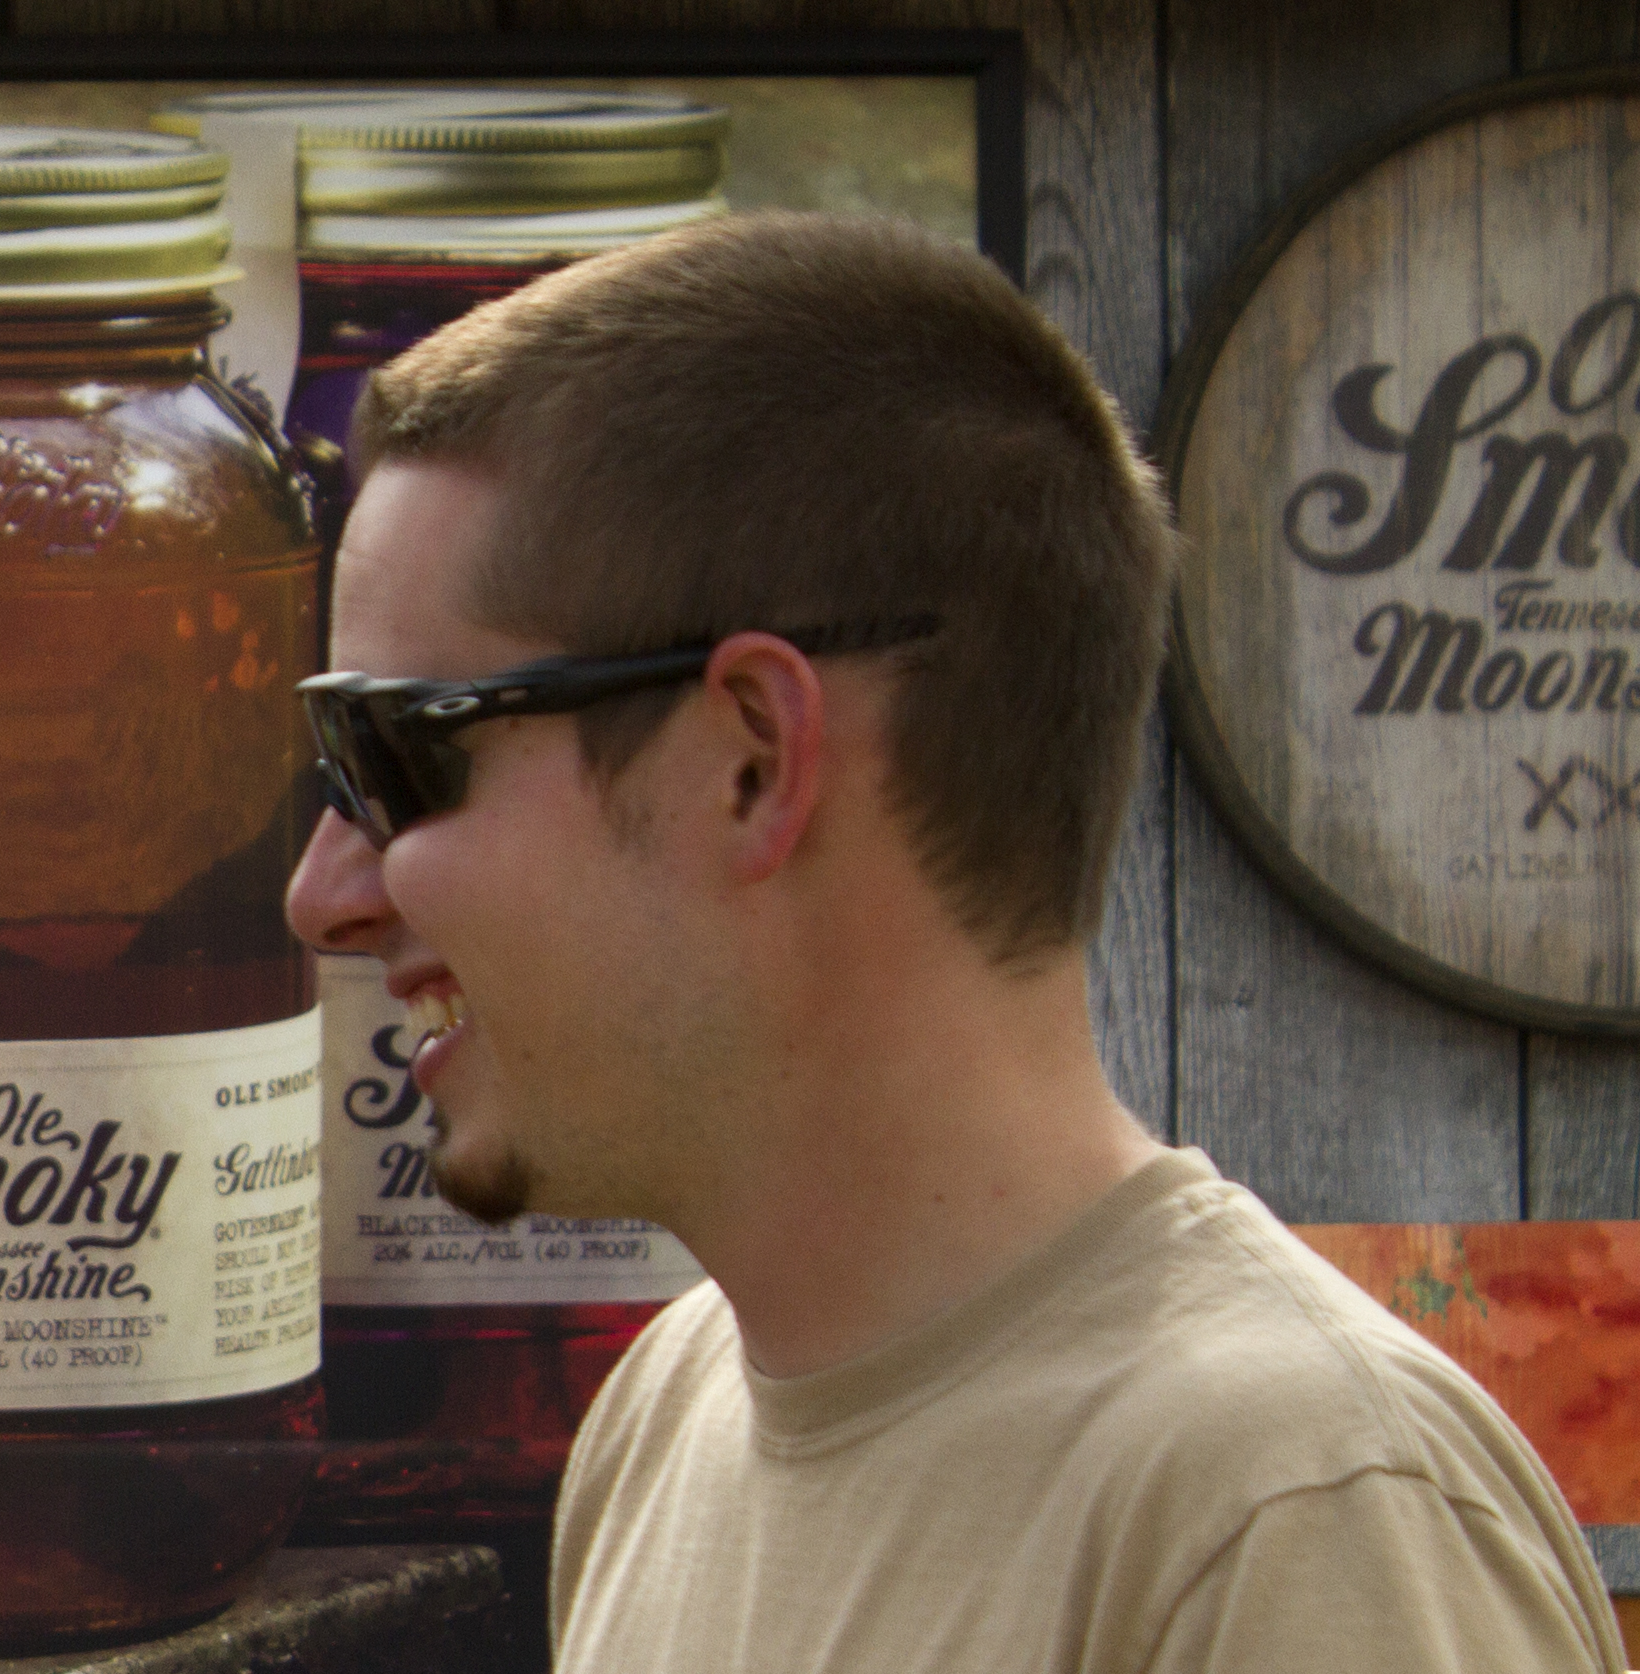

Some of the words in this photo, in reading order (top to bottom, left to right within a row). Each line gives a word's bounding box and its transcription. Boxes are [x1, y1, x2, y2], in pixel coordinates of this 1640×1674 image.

[215, 1081, 261, 1108] OLE
[19, 1346, 59, 1371] (40
[68, 1341, 143, 1368] PROOF)
